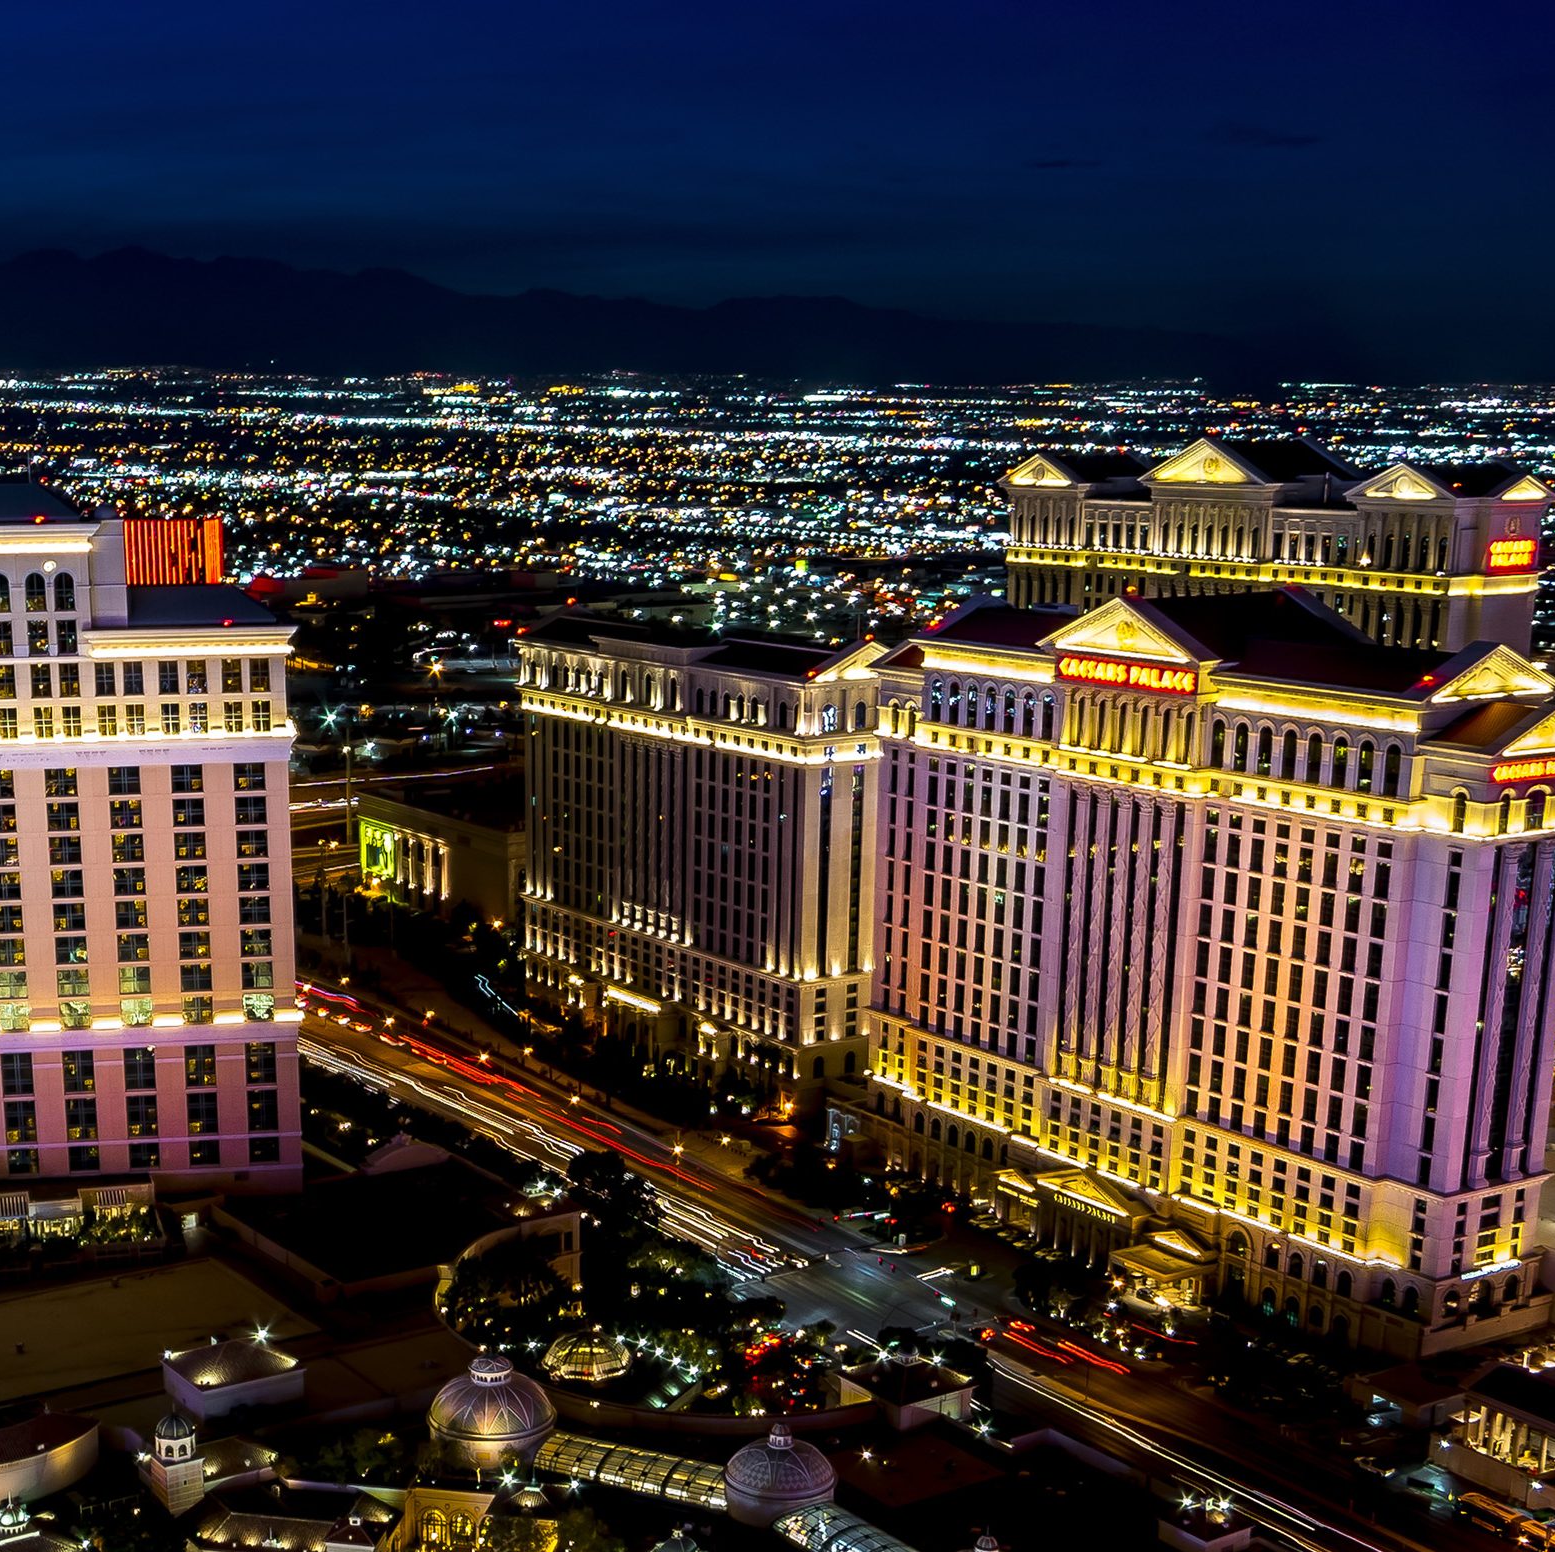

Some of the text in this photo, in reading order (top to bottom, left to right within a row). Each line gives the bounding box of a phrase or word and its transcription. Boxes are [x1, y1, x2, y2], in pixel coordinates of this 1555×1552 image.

[1058, 657, 1196, 692] CAESARS PALACE
[1493, 761, 1545, 781] CAESARS
